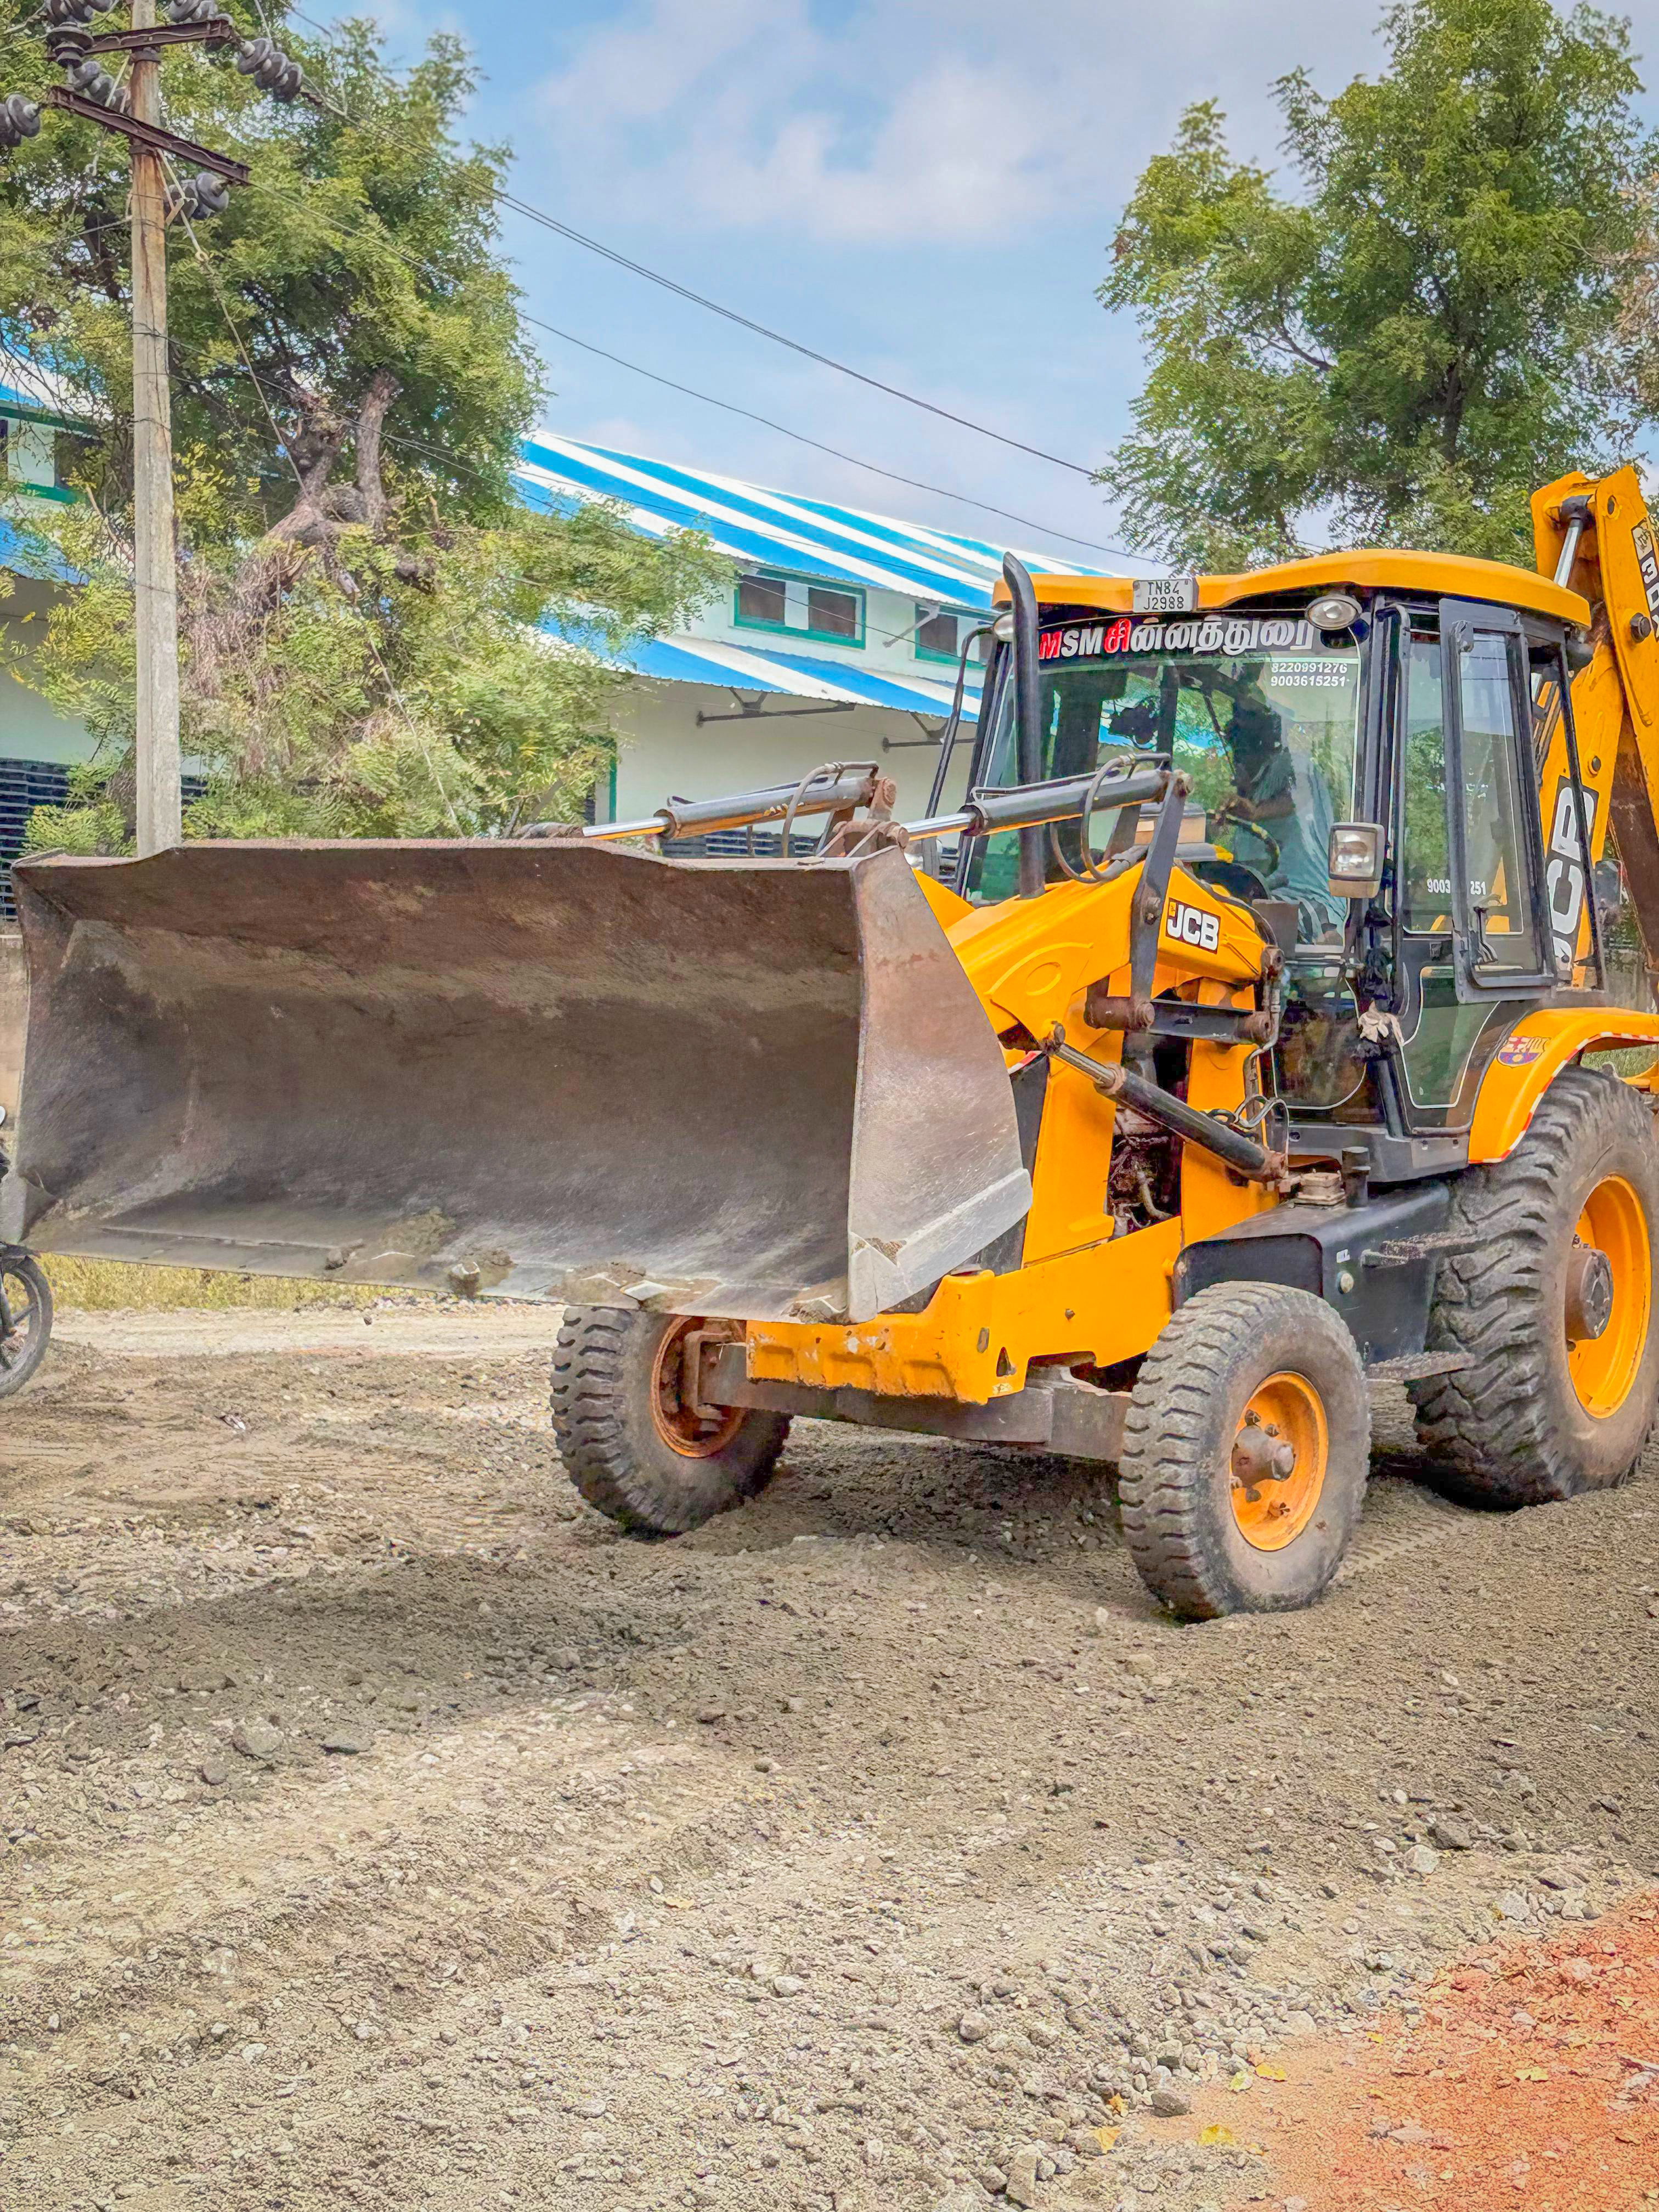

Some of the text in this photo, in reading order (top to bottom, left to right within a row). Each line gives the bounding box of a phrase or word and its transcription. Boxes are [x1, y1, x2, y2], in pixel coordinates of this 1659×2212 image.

[1147, 581, 1179, 595] TN84
[1143, 596, 1184, 610] J2988
[1039, 627, 1105, 659] MSM
[1271, 675, 1346, 687] 9003615251
[1167, 904, 1219, 950] JCB
